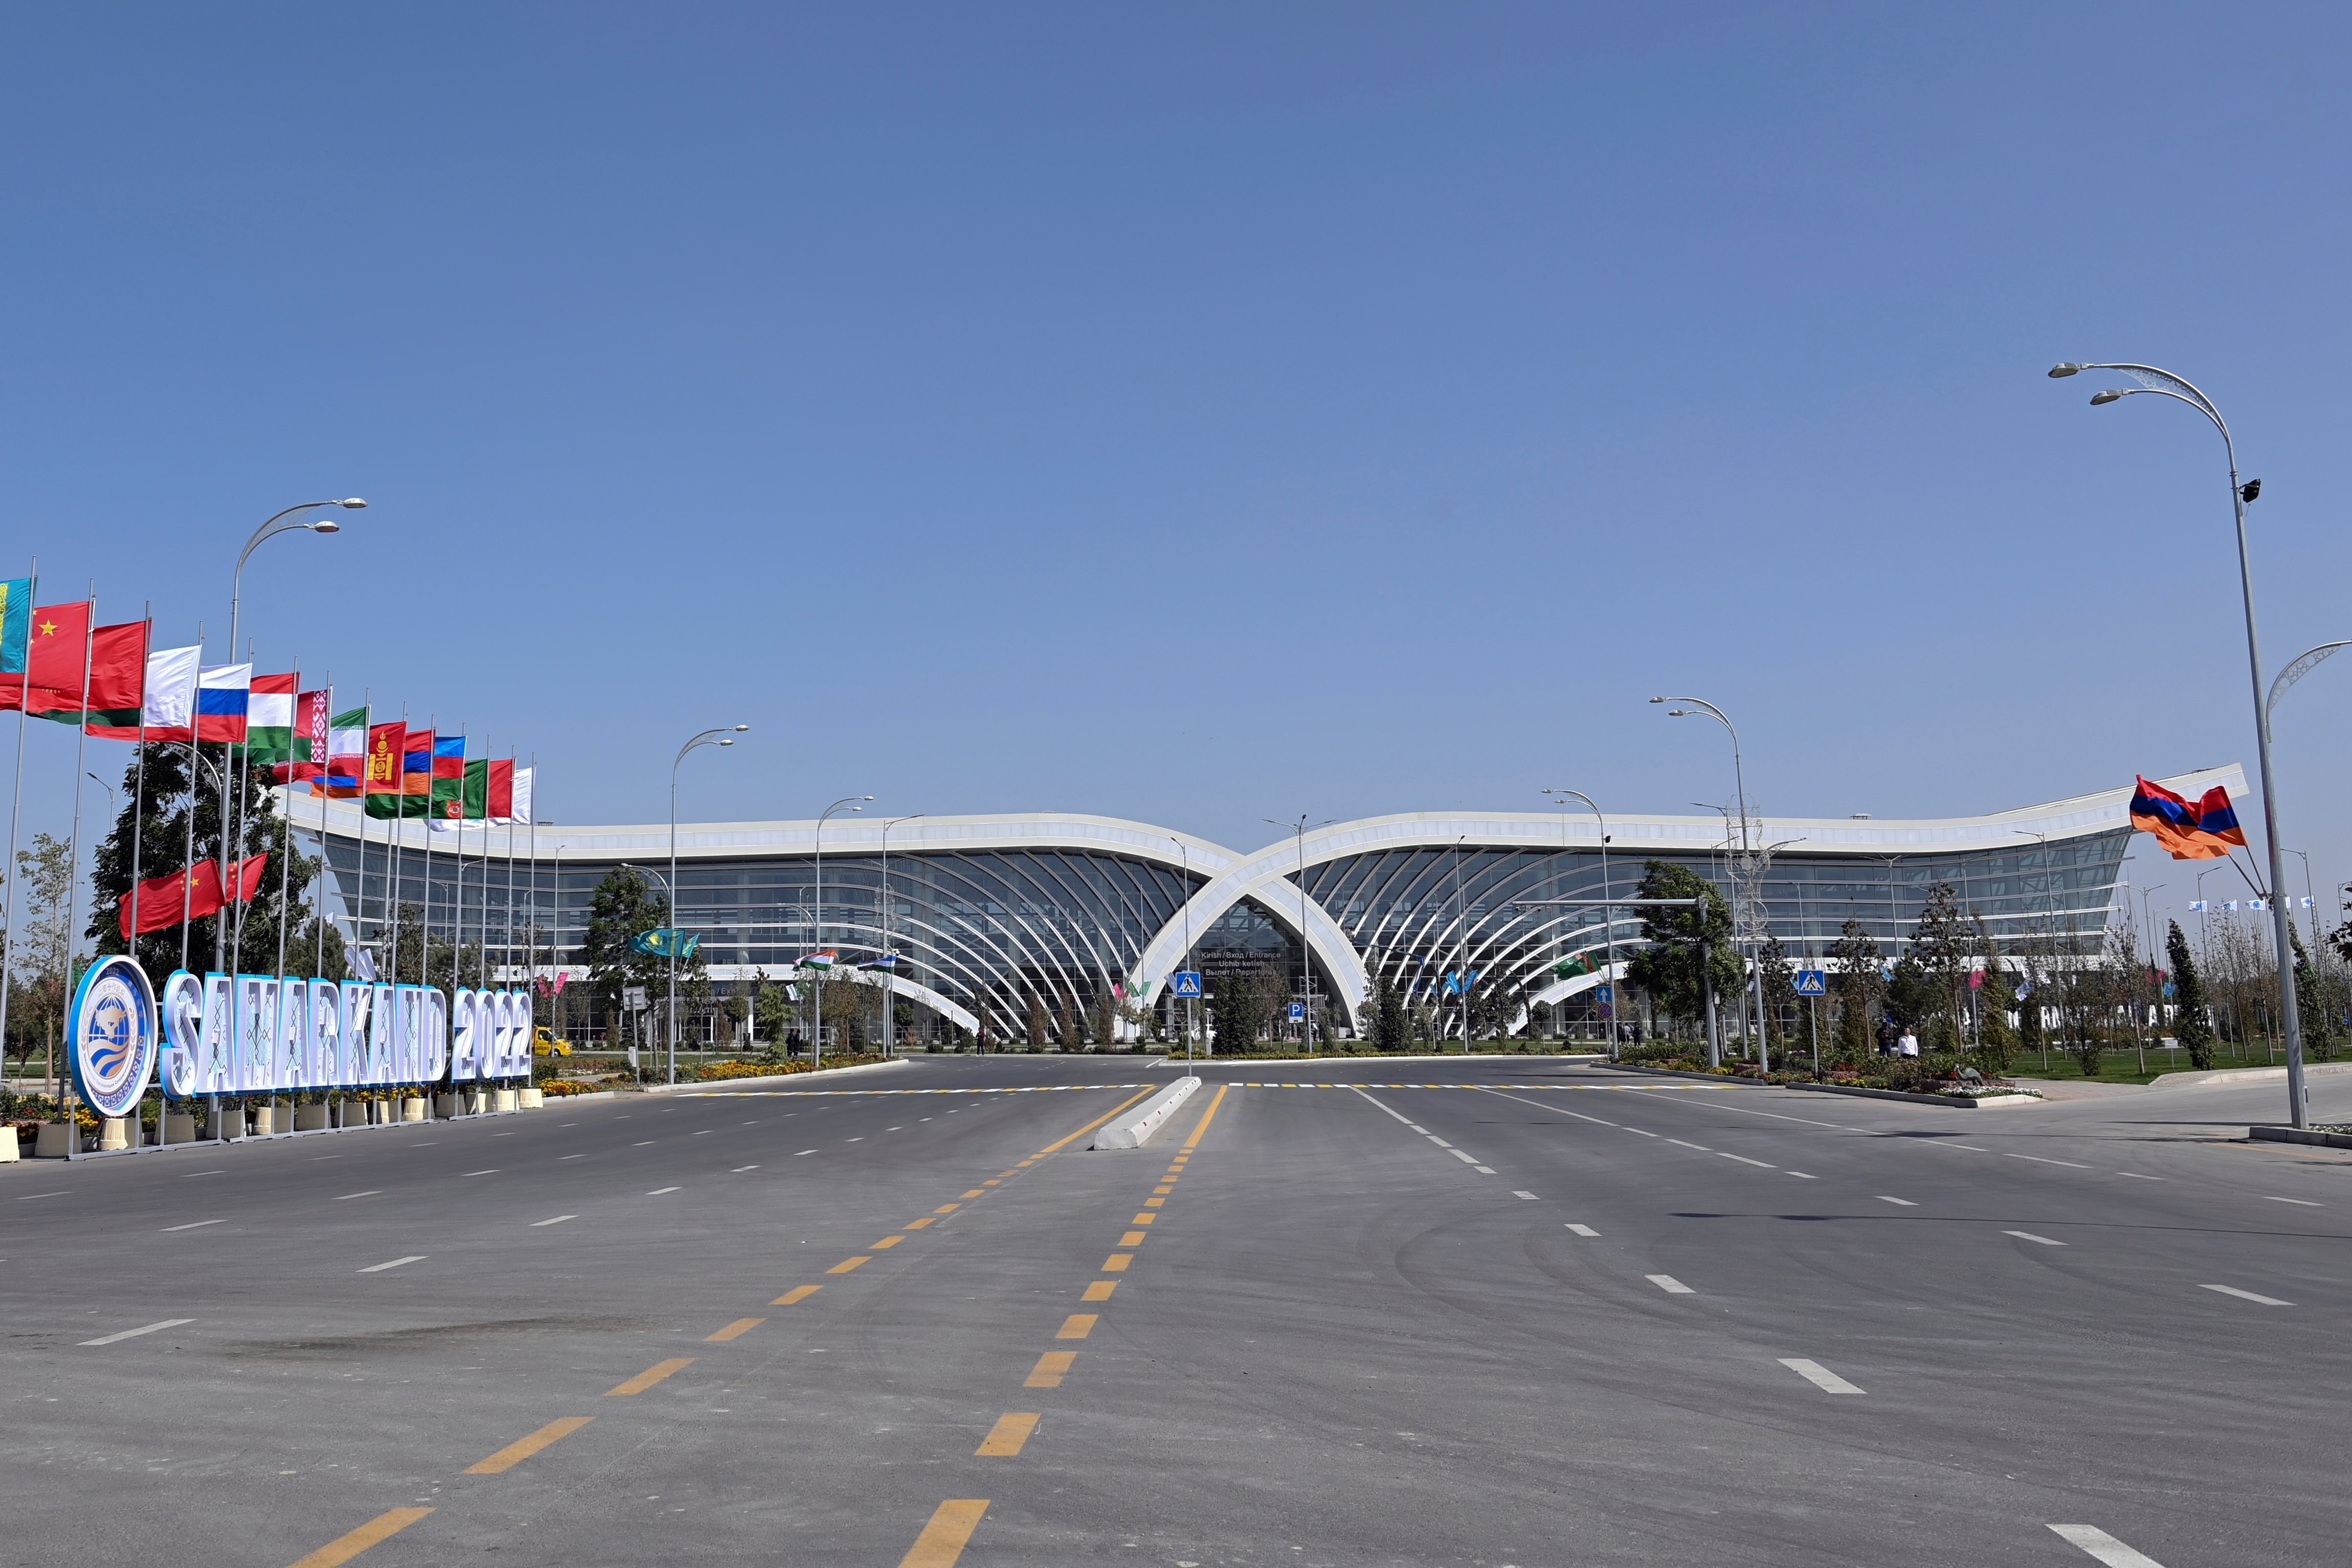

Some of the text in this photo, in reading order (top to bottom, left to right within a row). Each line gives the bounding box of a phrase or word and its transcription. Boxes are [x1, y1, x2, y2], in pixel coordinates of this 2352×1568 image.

[106, 967, 120, 976] 2022
[160, 969, 447, 1100] SAMARKAND
[451, 986, 532, 1084] 2022
[1292, 1004, 1300, 1016] P
